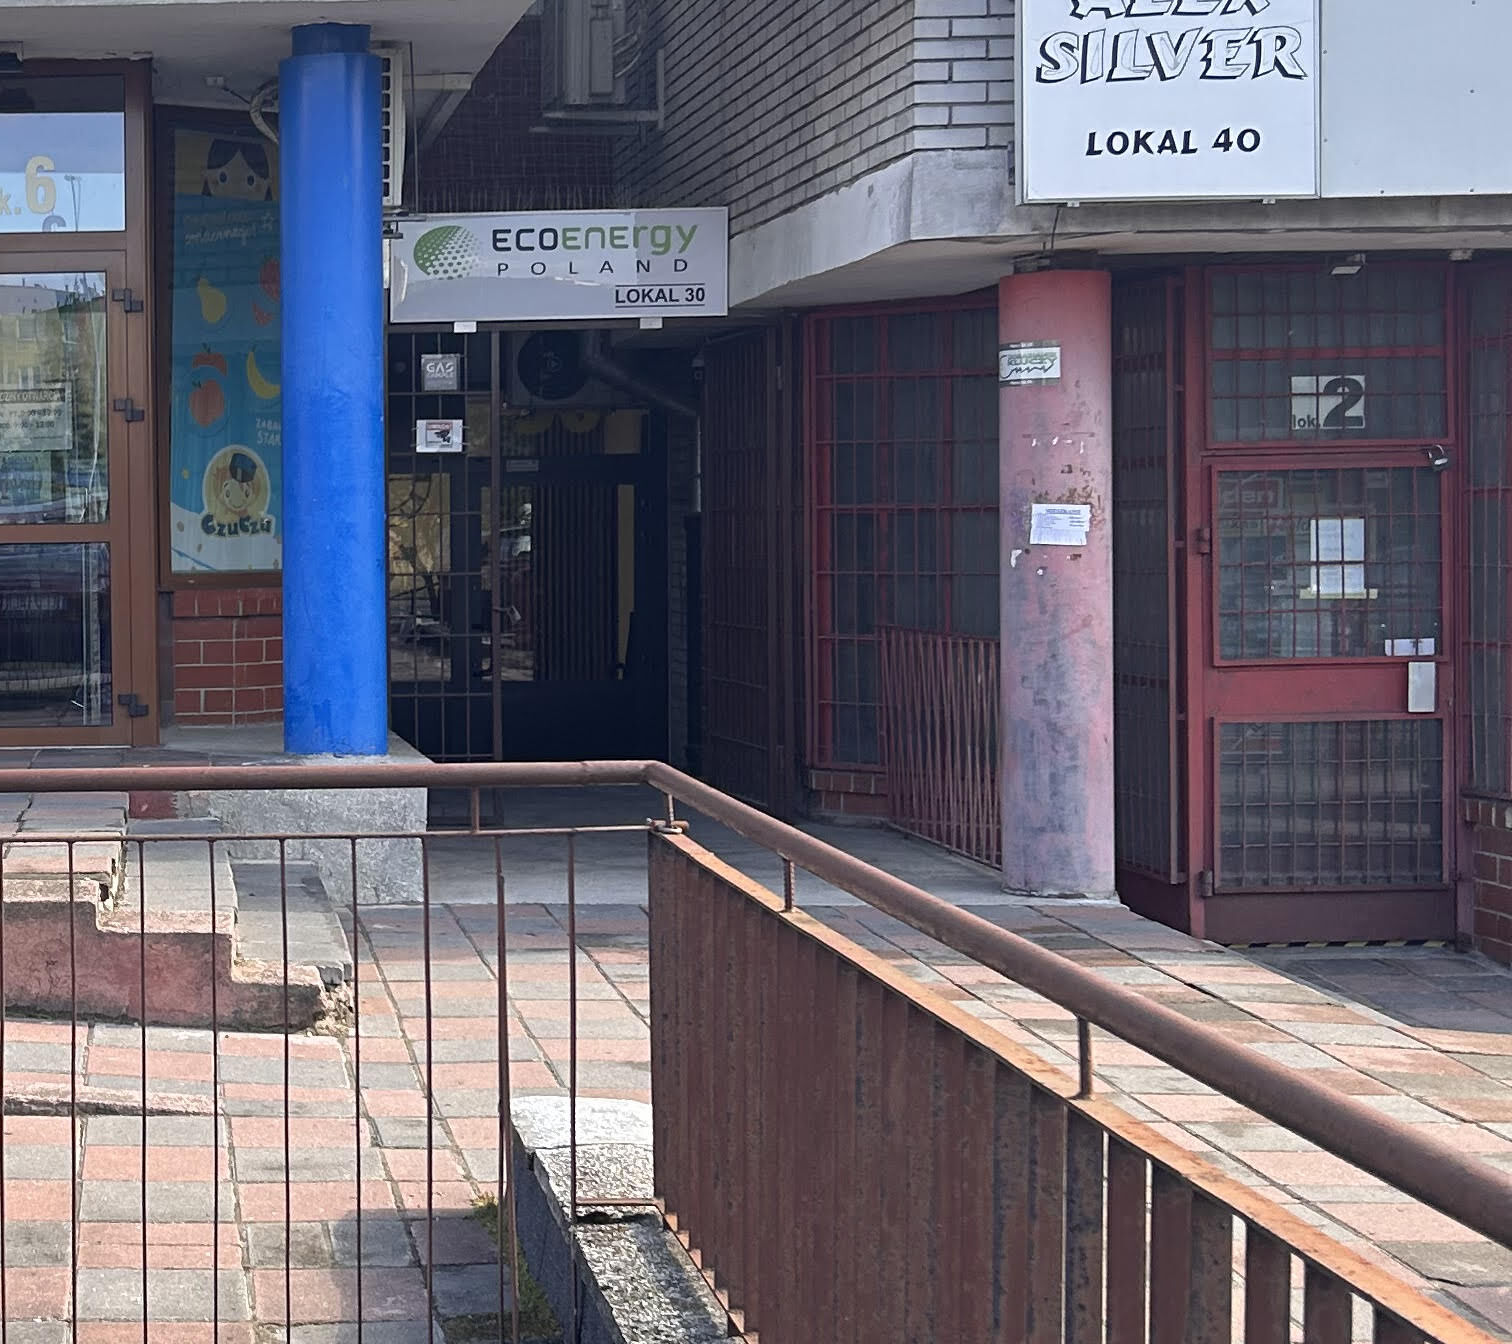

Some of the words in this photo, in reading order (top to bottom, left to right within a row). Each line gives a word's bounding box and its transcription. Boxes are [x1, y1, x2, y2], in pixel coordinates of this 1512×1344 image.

[1035, 24, 1307, 85] SILVER
[1085, 129, 1197, 156] LOKAL
[1212, 128, 1261, 153] 40
[25, 155, 56, 214] 6
[497, 259, 688, 276] POLAND
[615, 287, 679, 305] LOKAL
[685, 287, 705, 304] 30
[1322, 378, 1364, 428] 2
[201, 514, 272, 537] CzuCzu
